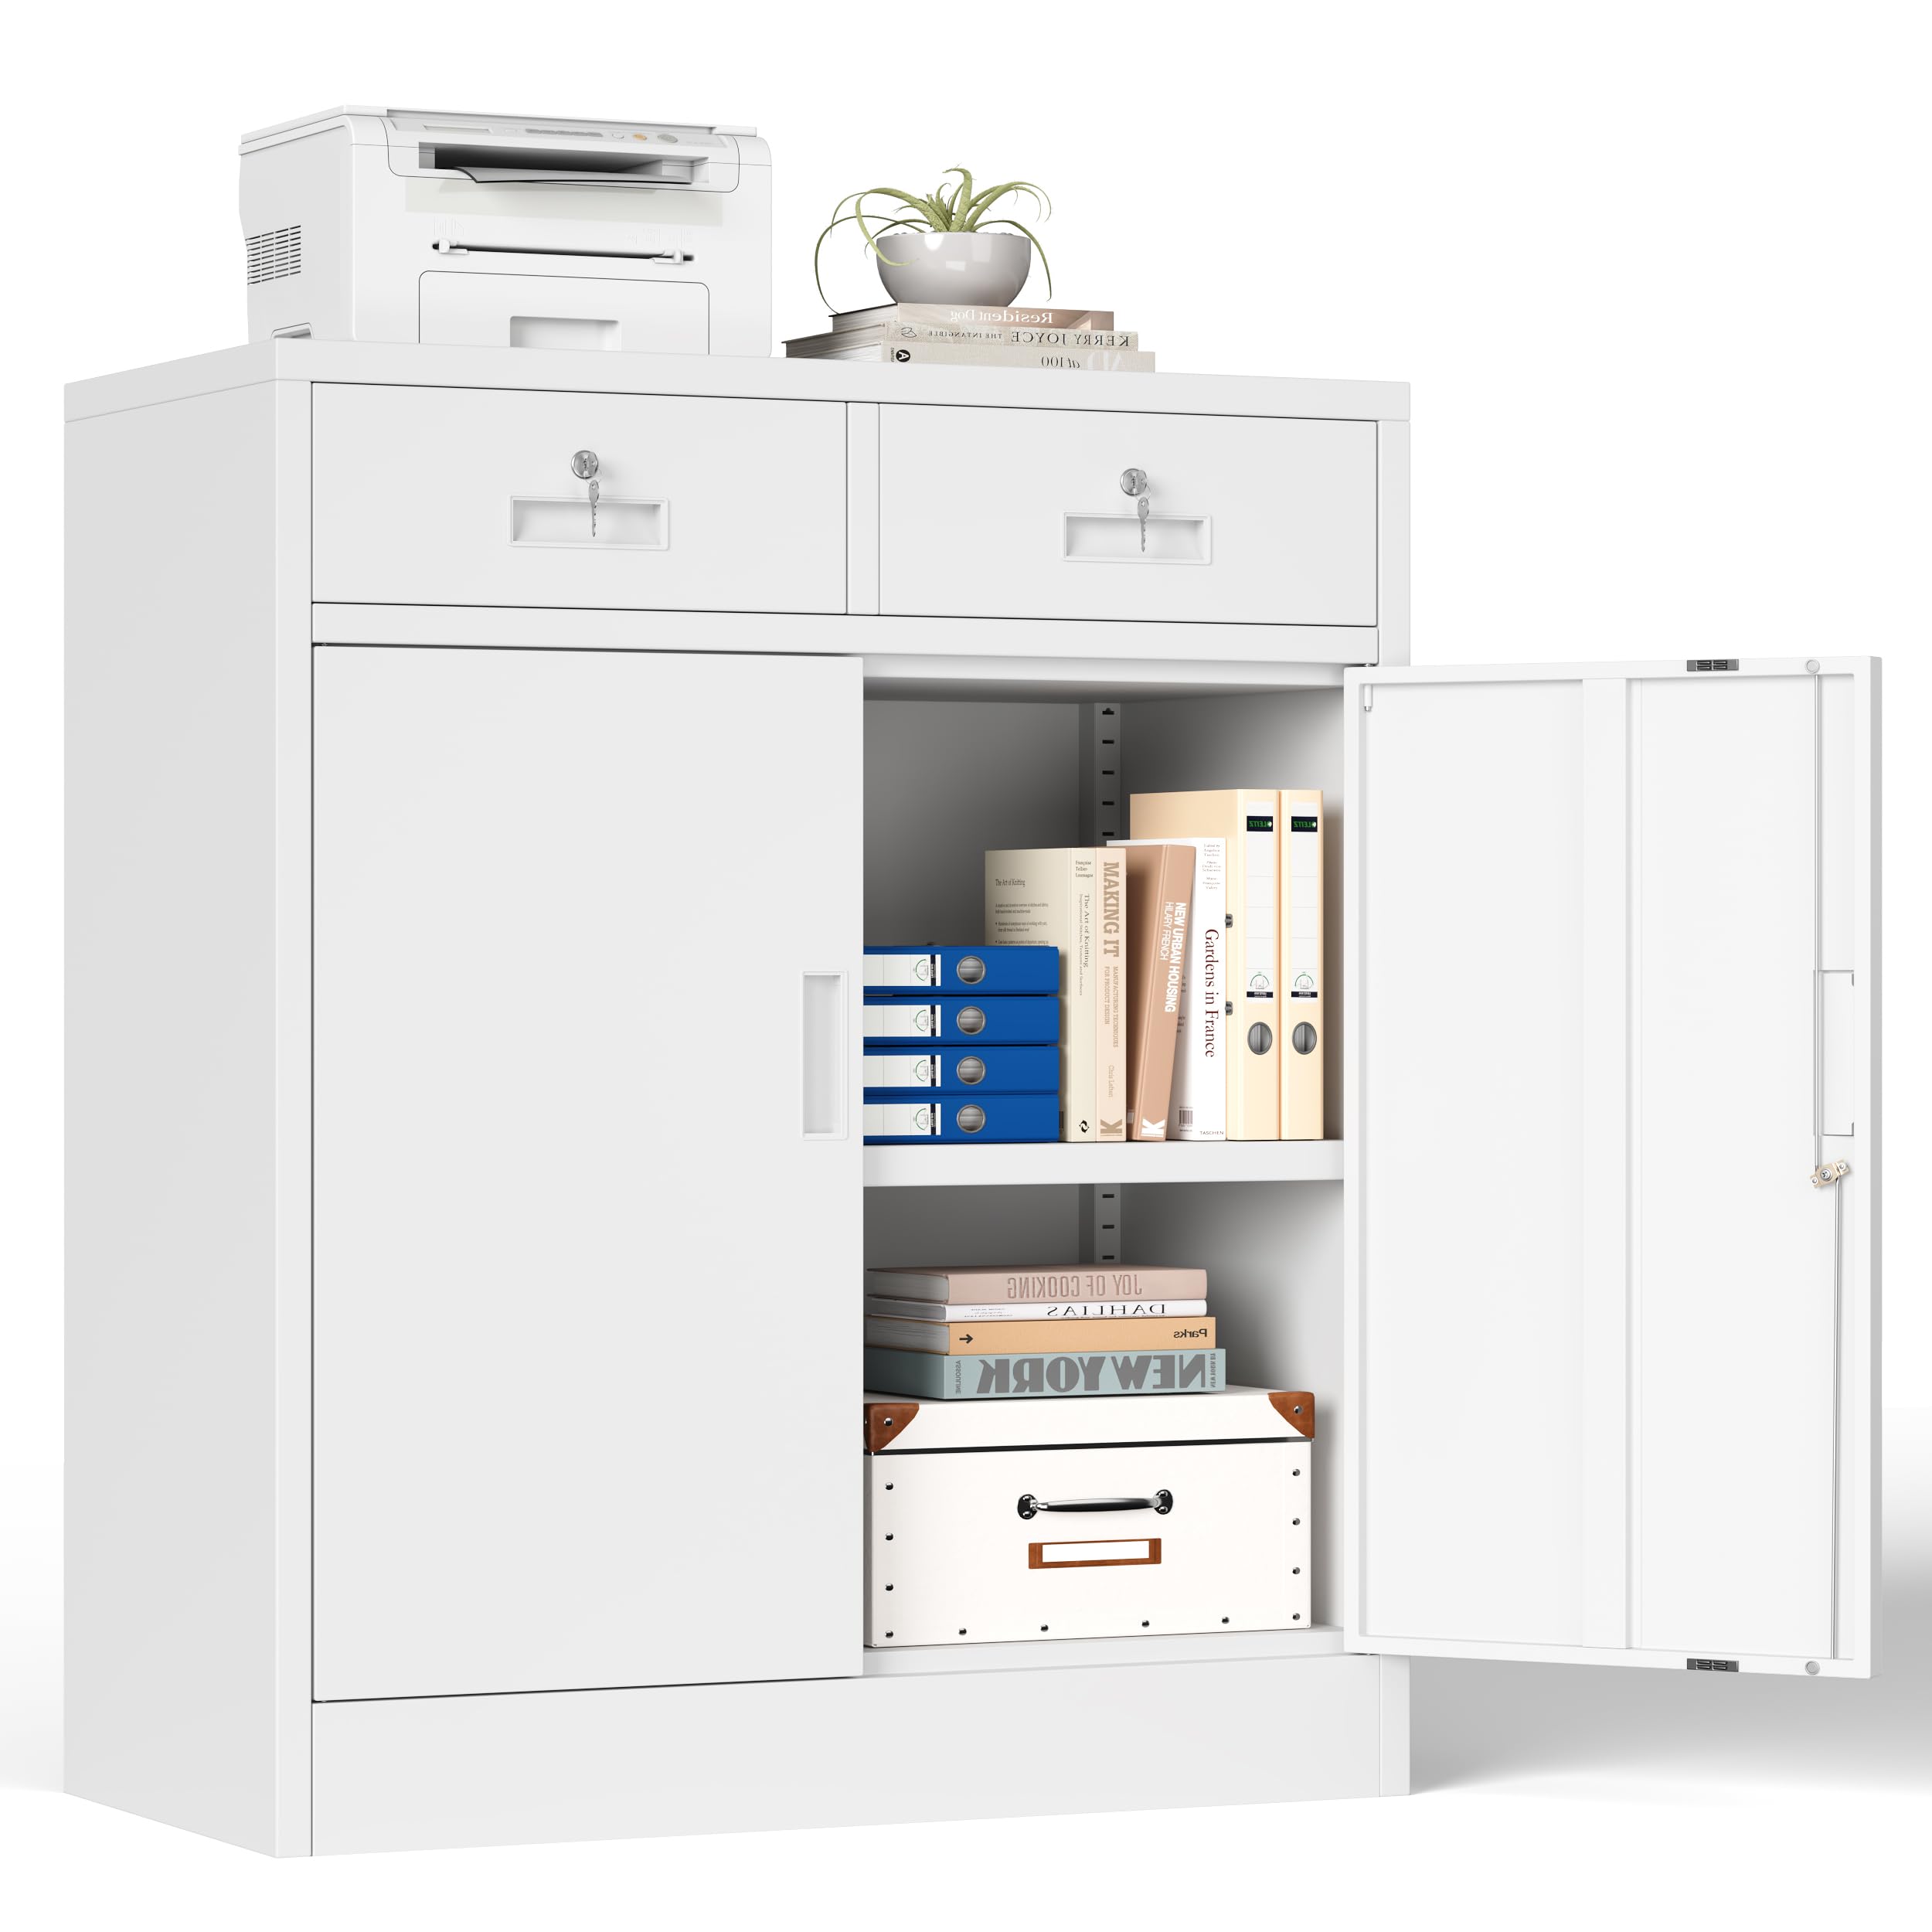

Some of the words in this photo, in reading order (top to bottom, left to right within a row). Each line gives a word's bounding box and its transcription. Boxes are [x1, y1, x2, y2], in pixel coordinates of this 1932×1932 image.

[1104, 862, 1120, 934] MAKING
[1084, 925, 1090, 934] of
[1163, 902, 1174, 928] HILARY
[1174, 902, 1186, 927] NEW
[1104, 940, 1120, 957] IT
[1159, 930, 1172, 961] FRENCH
[1170, 928, 1184, 964] URBAN
[1206, 929, 1219, 988] Gardens
[1165, 966, 1180, 1012] HOUSING
[1206, 992, 1219, 1005] in
[1206, 1010, 1219, 1057] France
